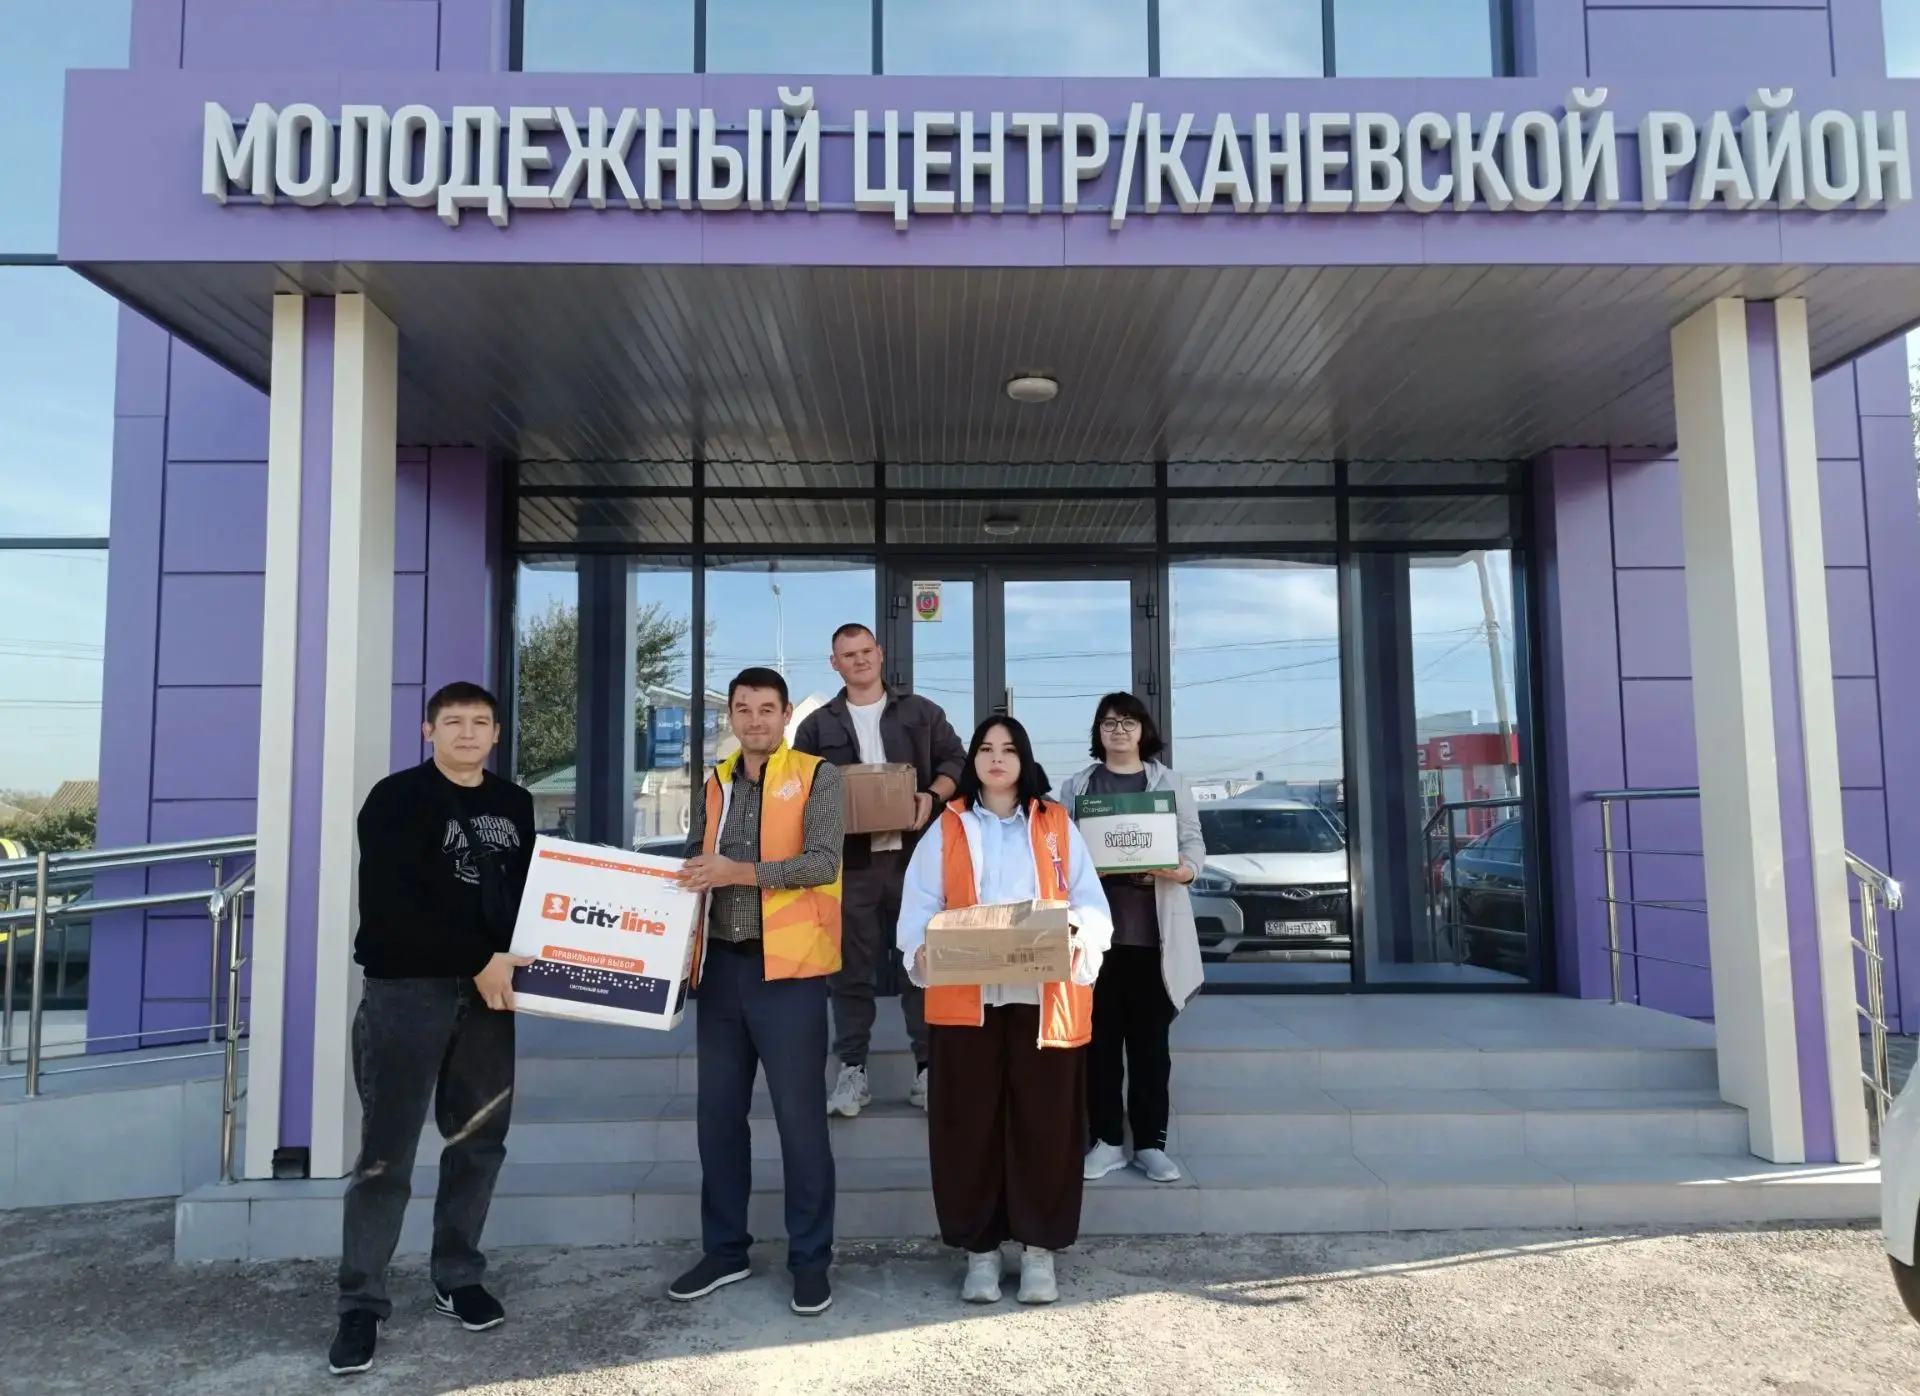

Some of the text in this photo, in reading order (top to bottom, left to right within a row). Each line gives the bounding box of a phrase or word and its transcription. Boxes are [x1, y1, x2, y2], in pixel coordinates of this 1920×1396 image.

[202, 86, 820, 226] МОЛОДЕЖНЫЙ
[1638, 87, 1912, 211] РАЙОН
[1105, 831, 1152, 848] SvetoCopy
[552, 949, 635, 969] ПРАВИЛЬНЫЙ ВЫБОР
